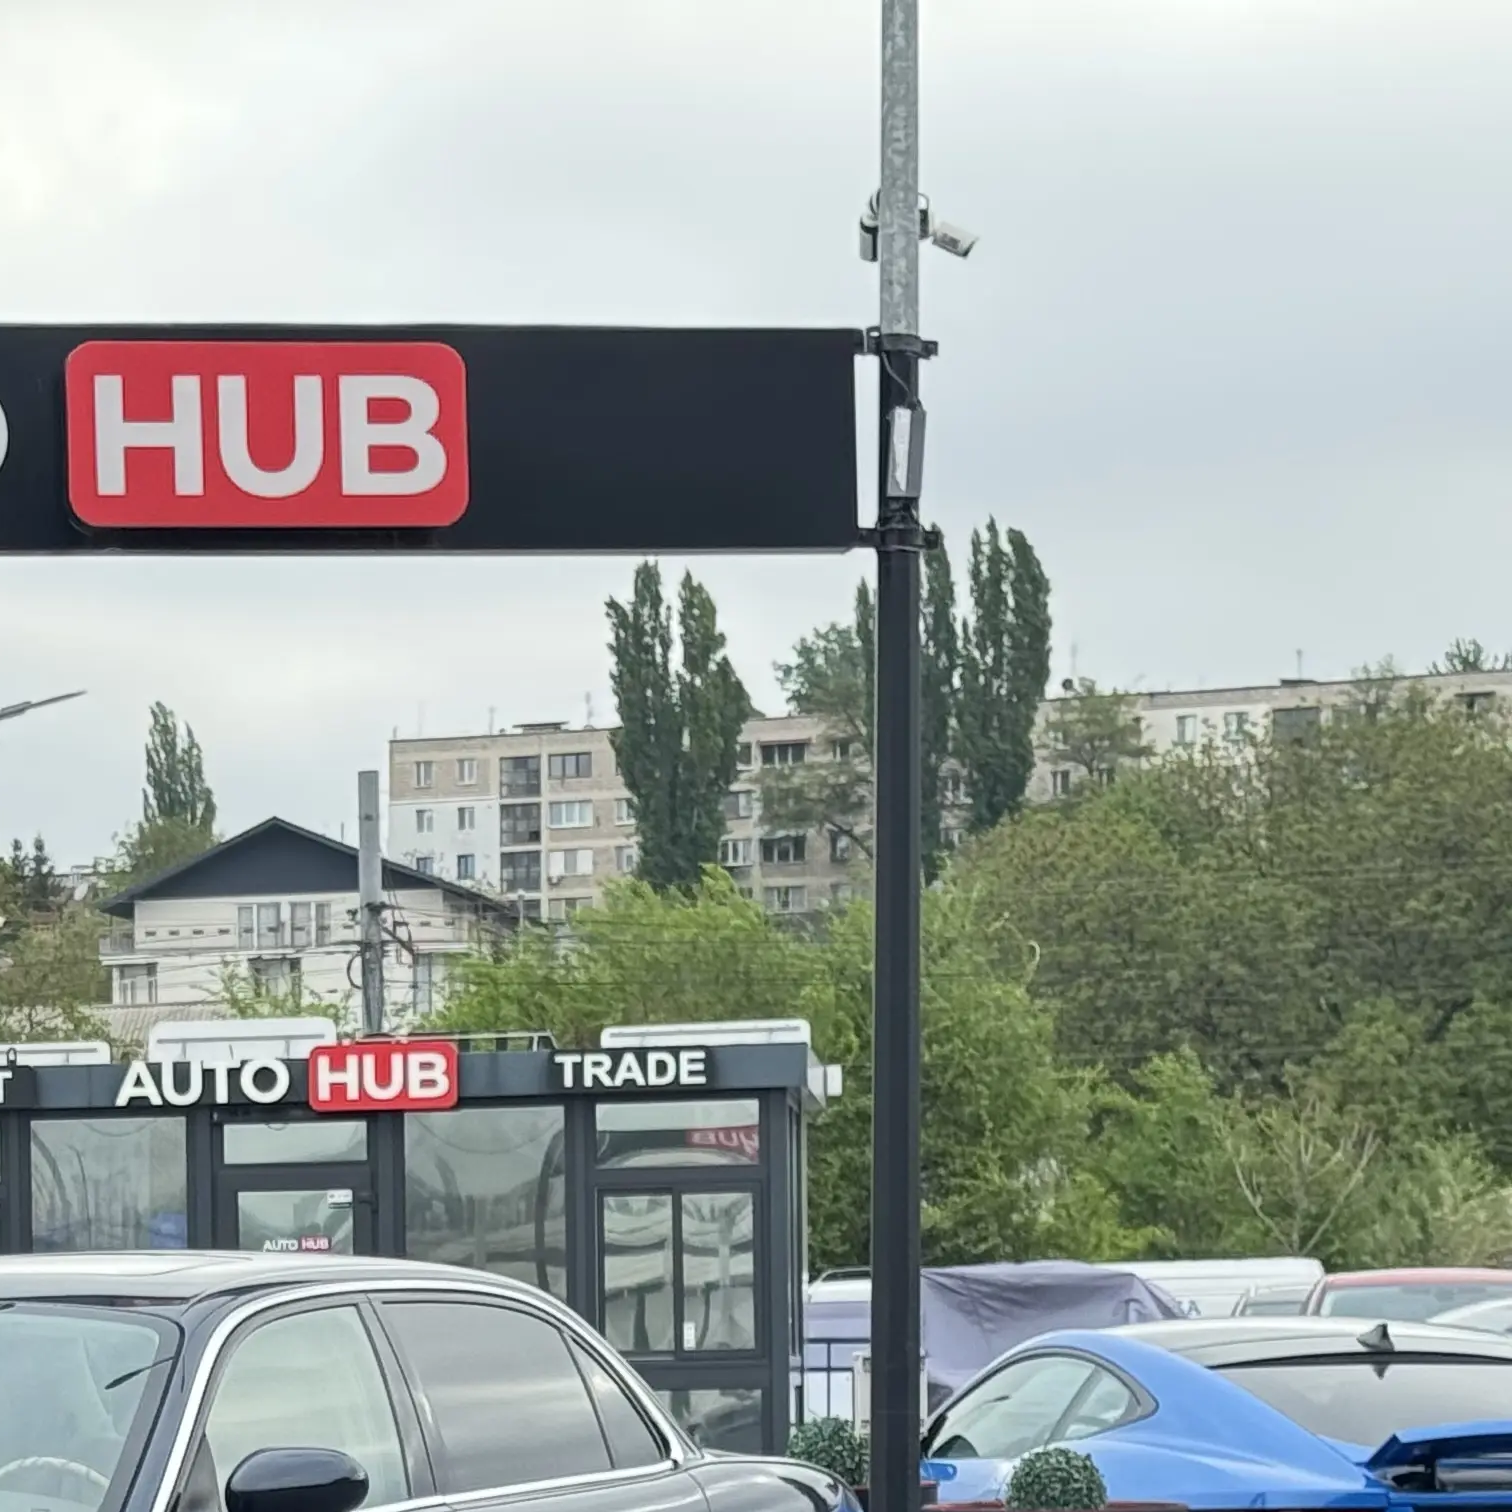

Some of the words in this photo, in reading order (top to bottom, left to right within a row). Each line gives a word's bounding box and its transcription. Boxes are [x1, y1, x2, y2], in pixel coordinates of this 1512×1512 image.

[94, 374, 447, 498] HUB
[115, 1058, 291, 1107] AUTO
[317, 1052, 450, 1101] HUB
[554, 1050, 707, 1088] TRADE
[263, 1239, 299, 1252] AUTO
[302, 1237, 329, 1250] HUB
